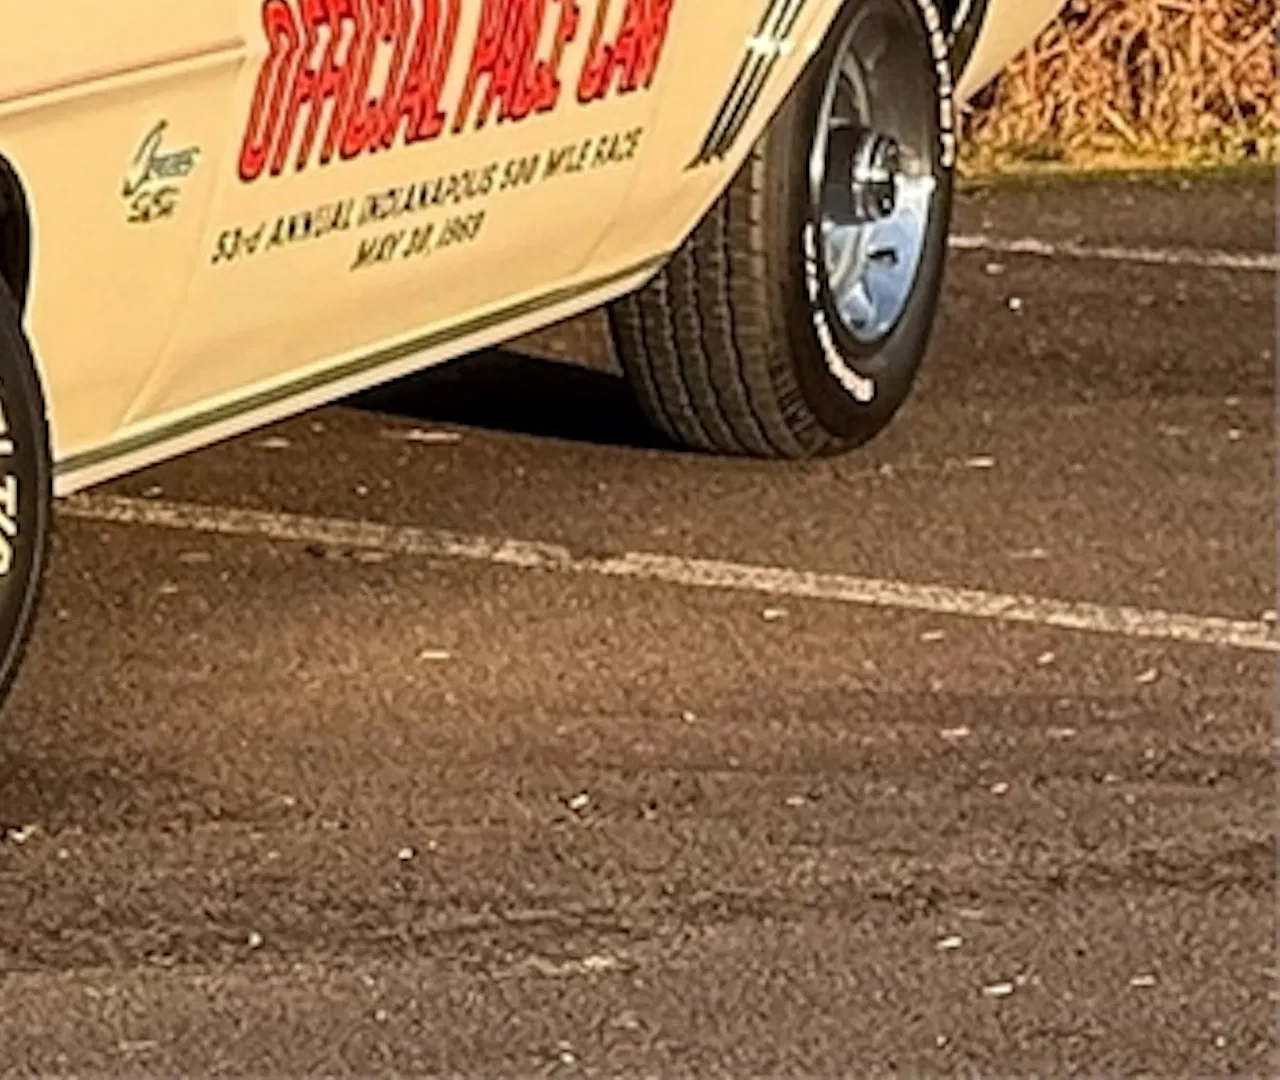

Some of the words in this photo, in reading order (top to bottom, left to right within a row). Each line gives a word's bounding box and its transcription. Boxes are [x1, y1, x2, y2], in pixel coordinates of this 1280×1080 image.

[211, 228, 265, 265] 53rd
[264, 200, 353, 252] ANNUAL
[356, 162, 499, 228] INDIANAPOLIS
[497, 153, 538, 191] 500
[541, 140, 592, 181] MILE
[589, 125, 645, 171] RACE
[350, 232, 402, 272] MAY
